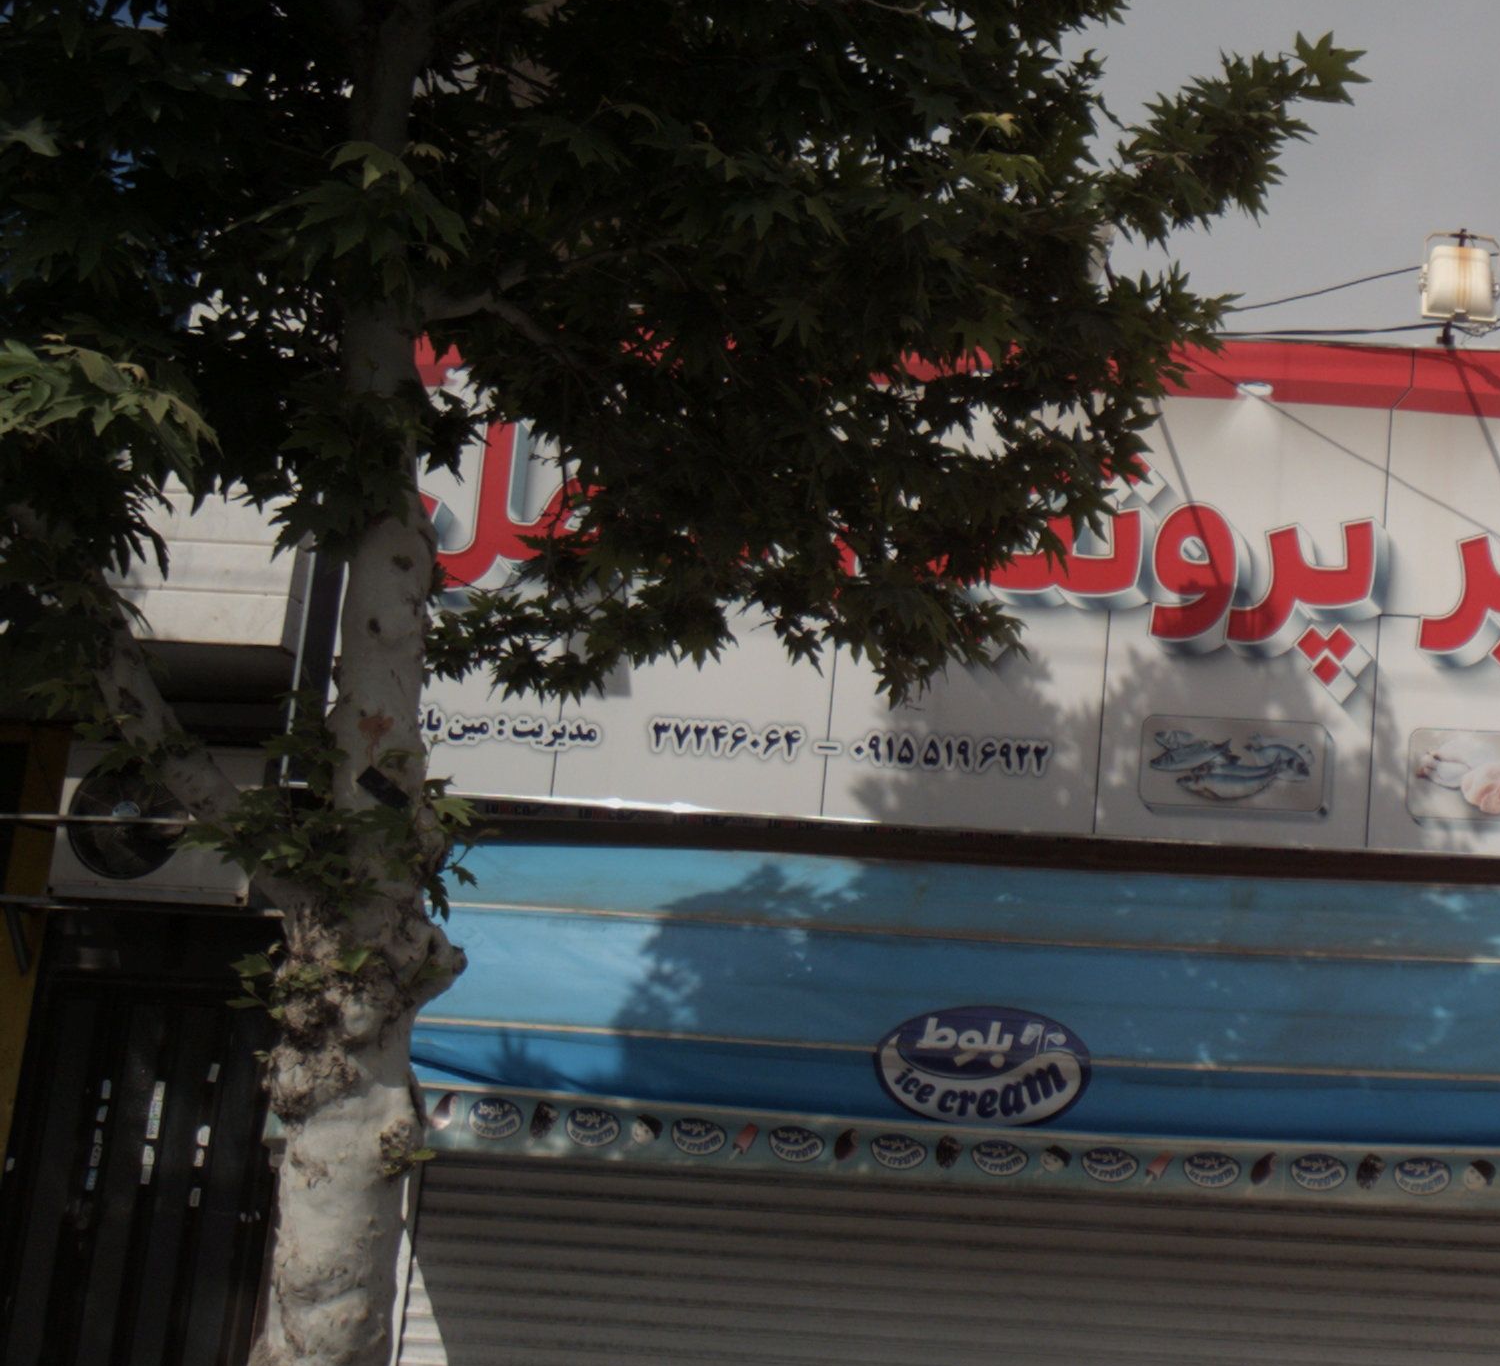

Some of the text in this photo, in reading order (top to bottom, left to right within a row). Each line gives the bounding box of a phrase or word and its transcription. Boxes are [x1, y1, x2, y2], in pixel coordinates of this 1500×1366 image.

[653, 721, 802, 757] ۳۷۲۴۶۰۶۴
[894, 1062, 1068, 1119] ice cream
